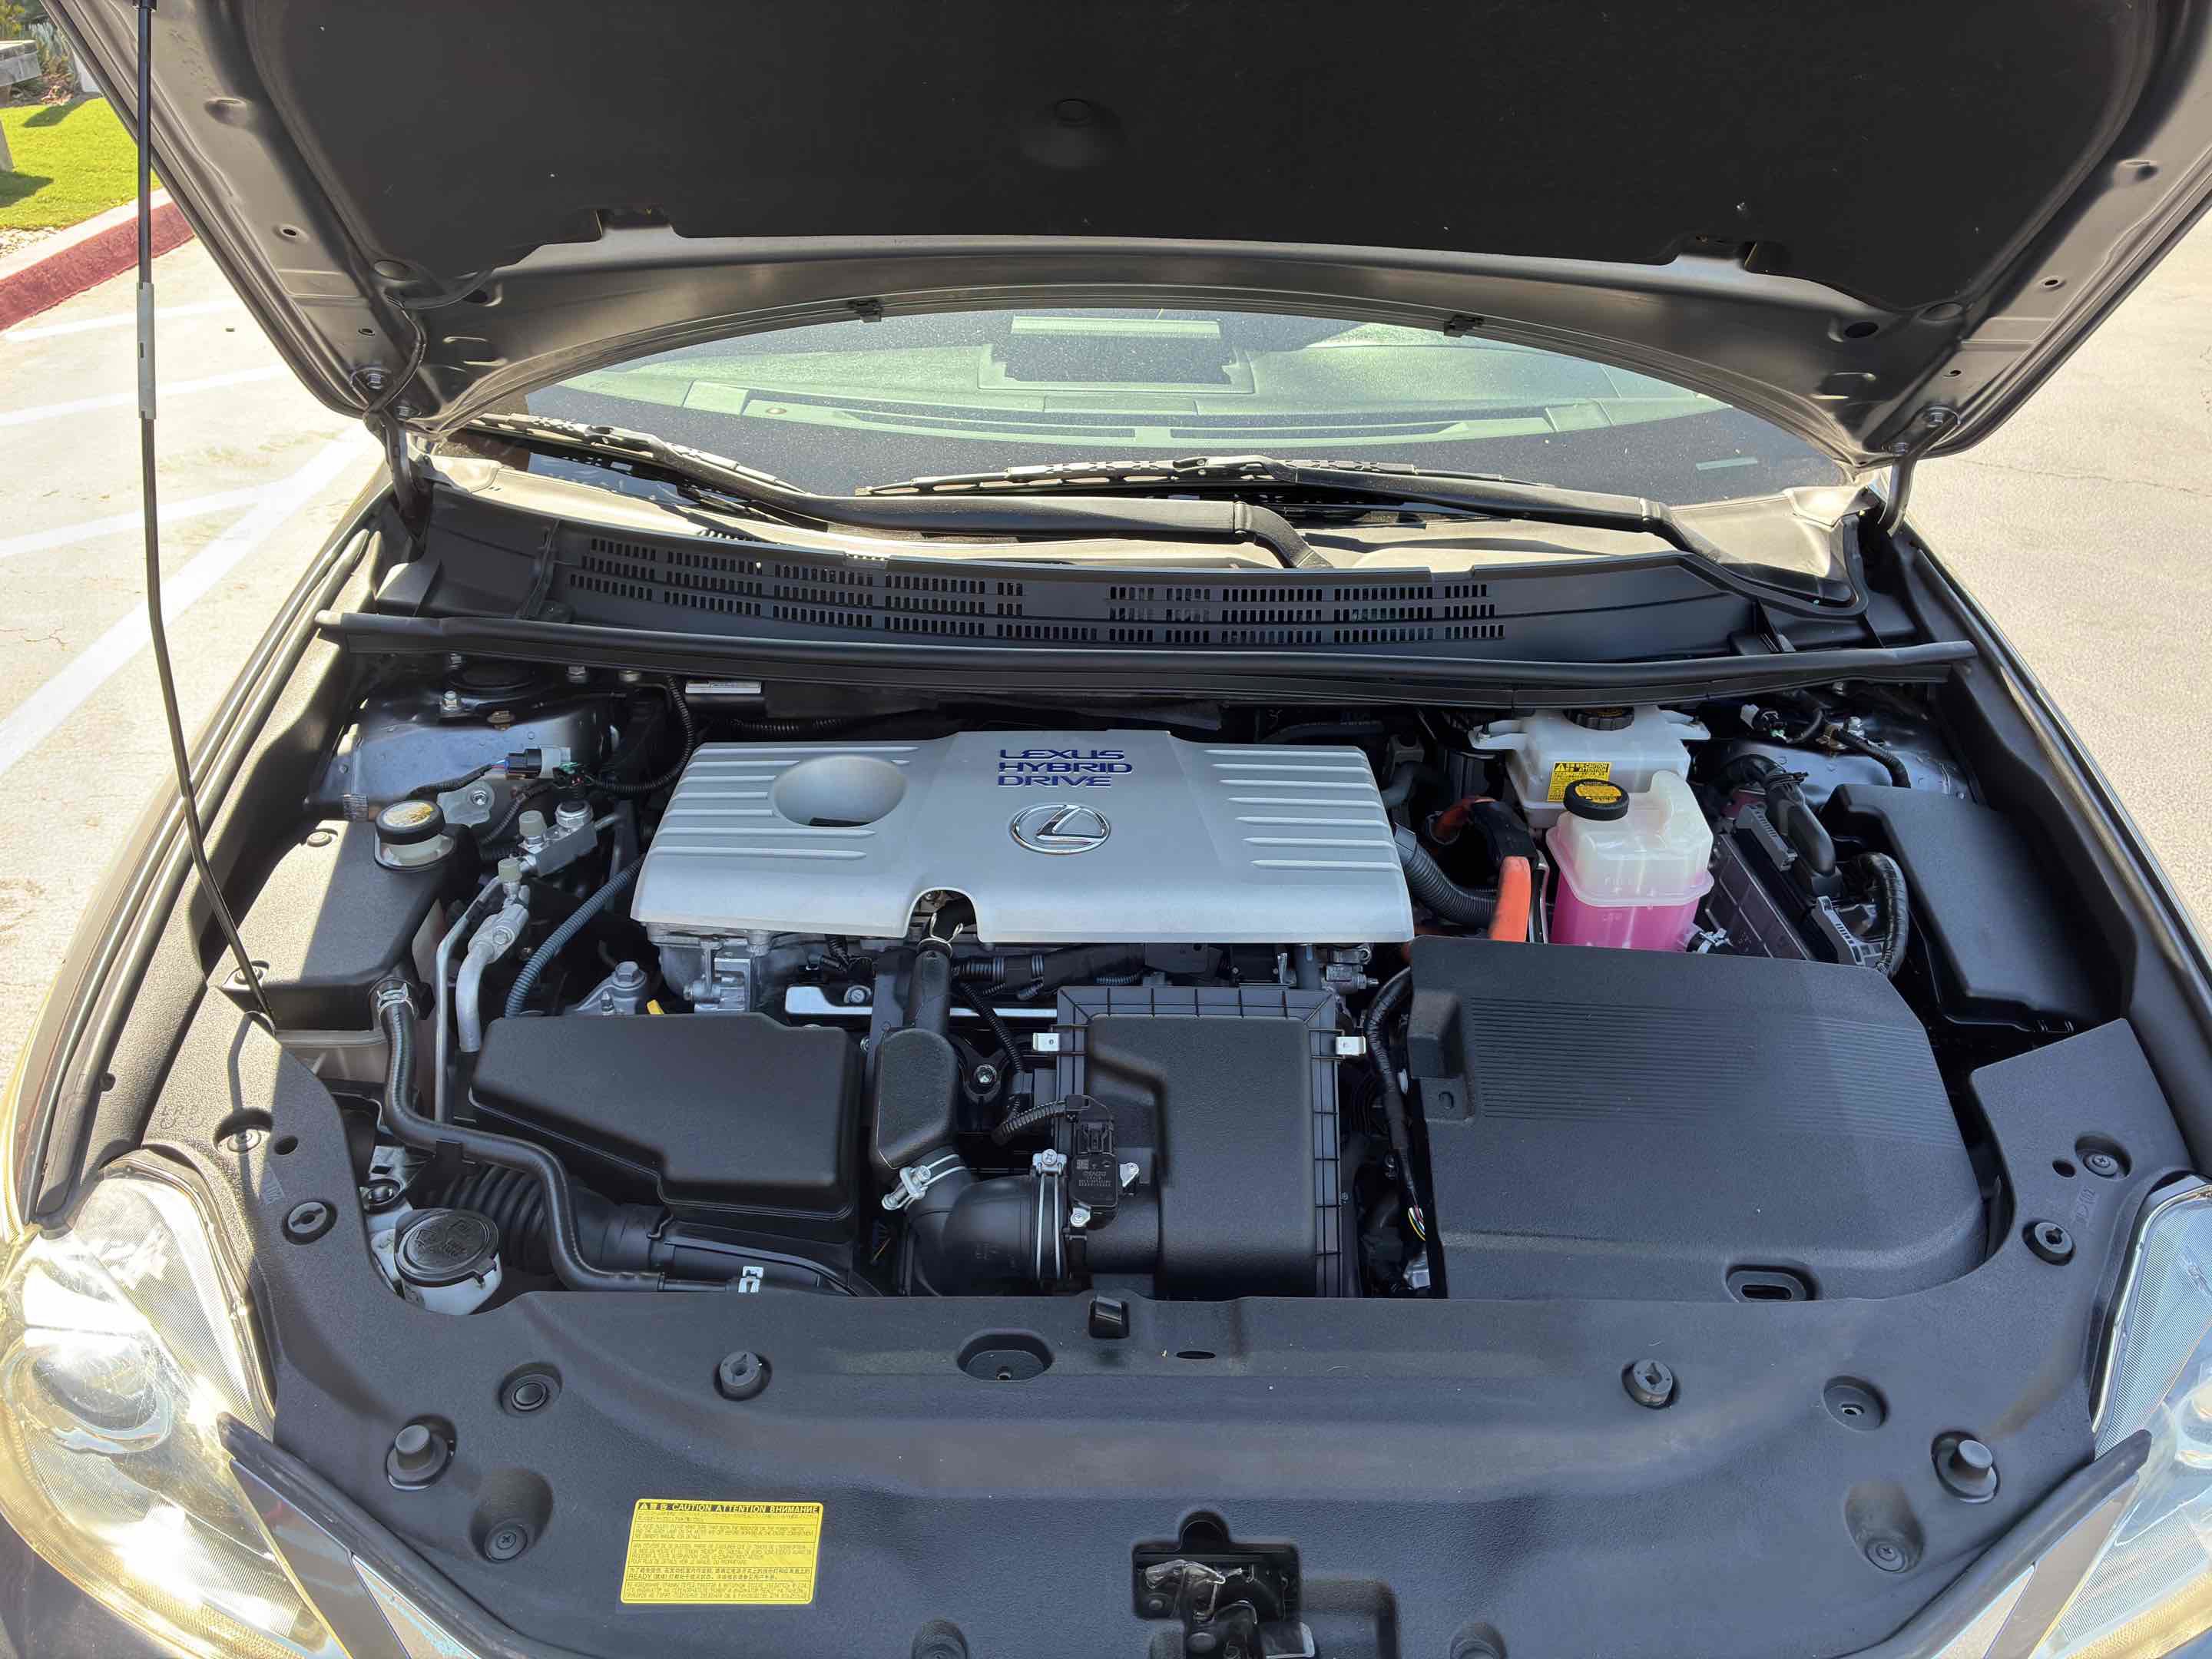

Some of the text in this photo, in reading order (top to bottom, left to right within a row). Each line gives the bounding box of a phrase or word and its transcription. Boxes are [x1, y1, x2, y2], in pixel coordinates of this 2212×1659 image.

[999, 749, 1124, 760] LEXUS
[998, 762, 1132, 773] HYBRID
[998, 776, 1112, 786] DRIVE
[672, 1503, 712, 1512] CAUTION
[716, 1504, 767, 1513] ATTENTION
